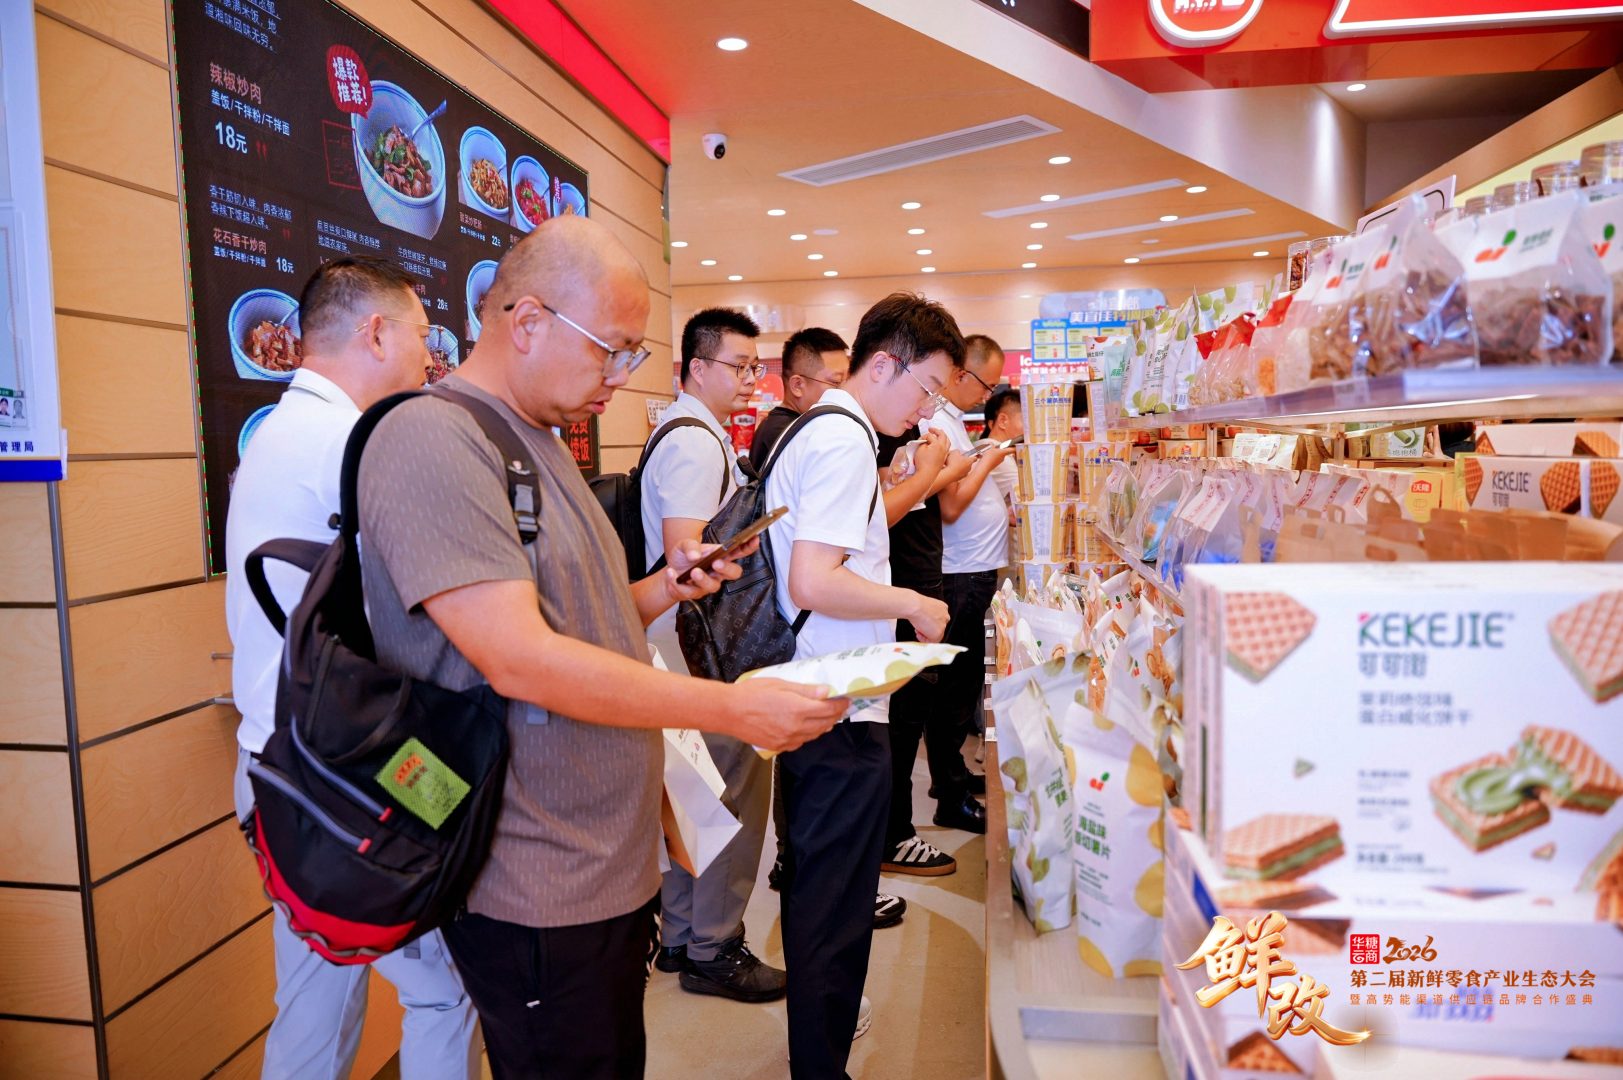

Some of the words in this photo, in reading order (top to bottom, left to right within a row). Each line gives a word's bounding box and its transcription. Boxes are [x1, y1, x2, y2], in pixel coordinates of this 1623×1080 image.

[333, 56, 359, 80] 爆款
[210, 62, 262, 105] 辣椒炒肉
[211, 89, 290, 136] 盖饭/干拌粉/干拌面
[215, 121, 248, 154] 18元
[213, 227, 267, 255] 花石香干炒肉
[276, 257, 294, 274] 18元
[1492, 470, 1529, 493] KEKEJIE
[1358, 612, 1505, 648] KEKEJIE
